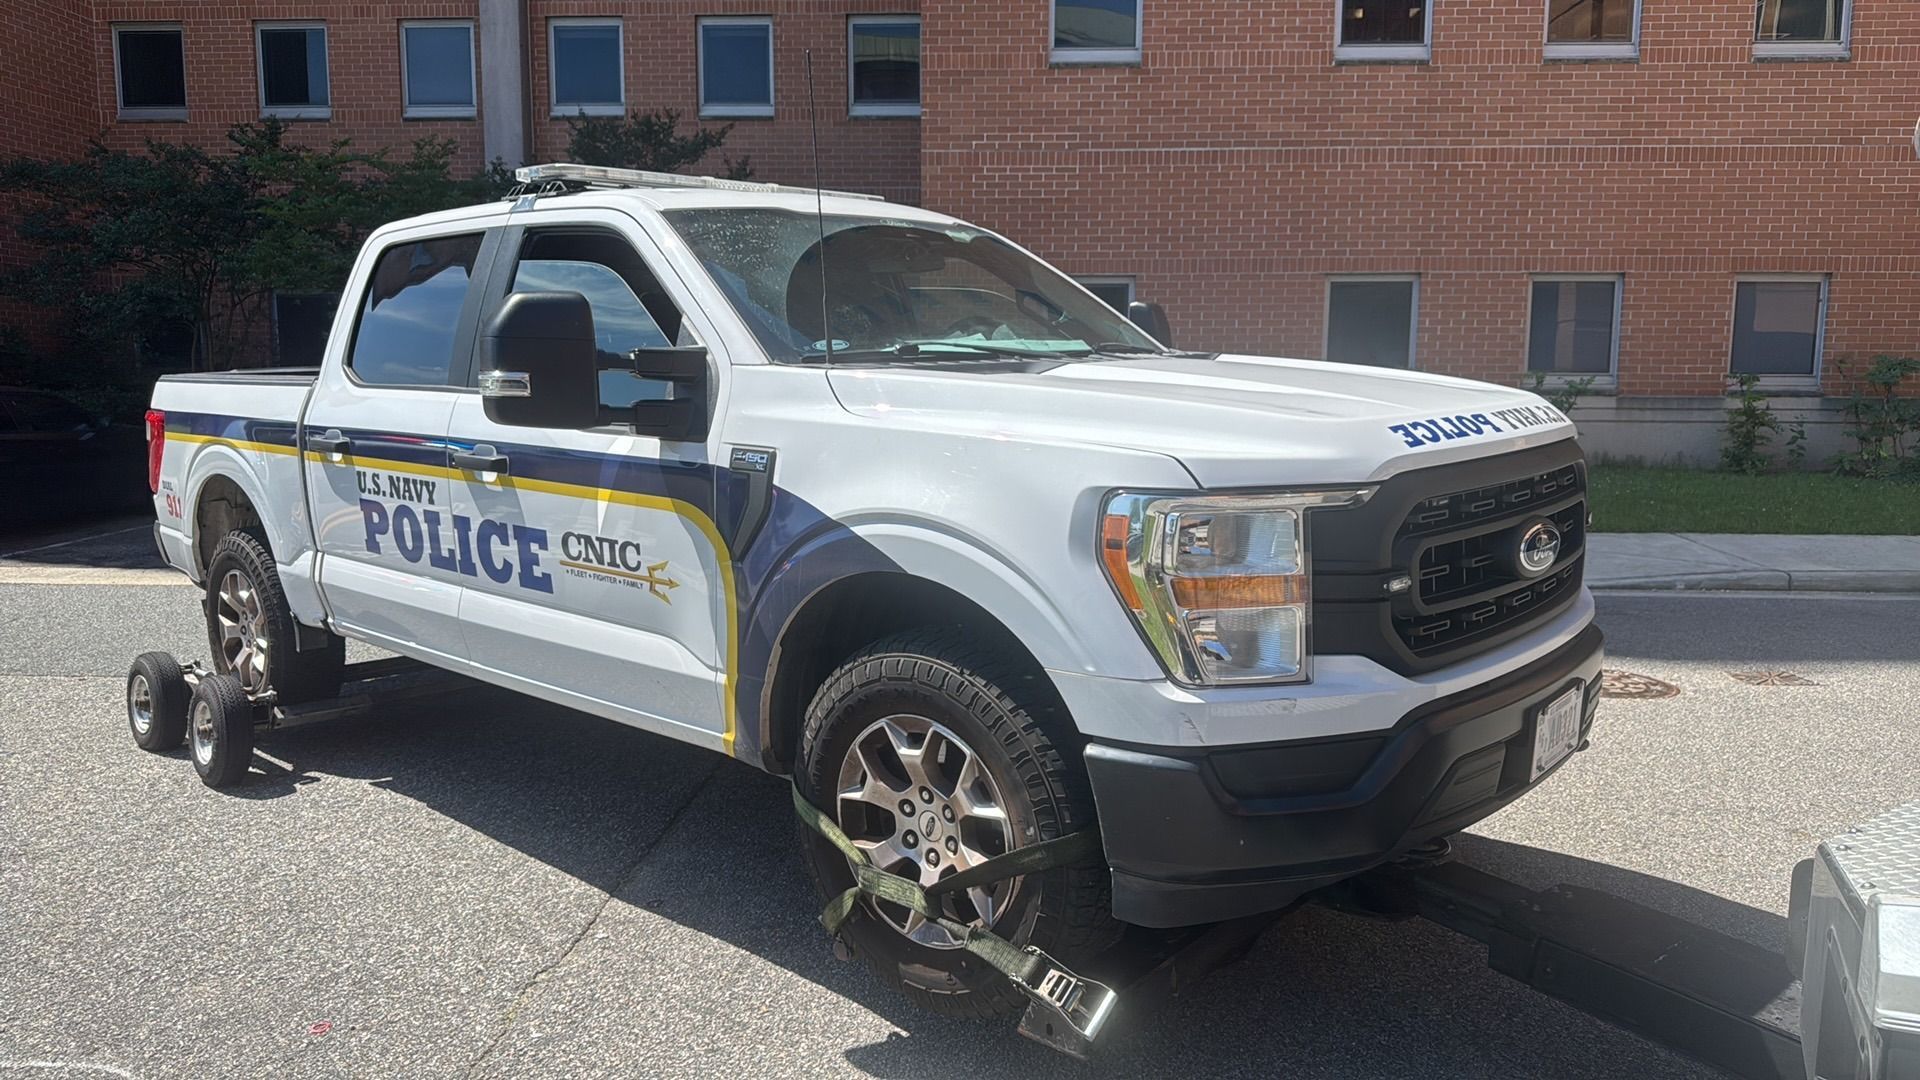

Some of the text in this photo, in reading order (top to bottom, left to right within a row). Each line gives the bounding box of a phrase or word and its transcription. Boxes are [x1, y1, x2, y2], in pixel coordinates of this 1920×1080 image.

[732, 450, 768, 463] F-150
[356, 470, 436, 505] U.S. NAVY
[166, 494, 182, 519] 911
[359, 497, 554, 594] POLICE
[561, 531, 642, 573] CNIC
[570, 569, 644, 590] FLEET FIGHTER FAMILY
